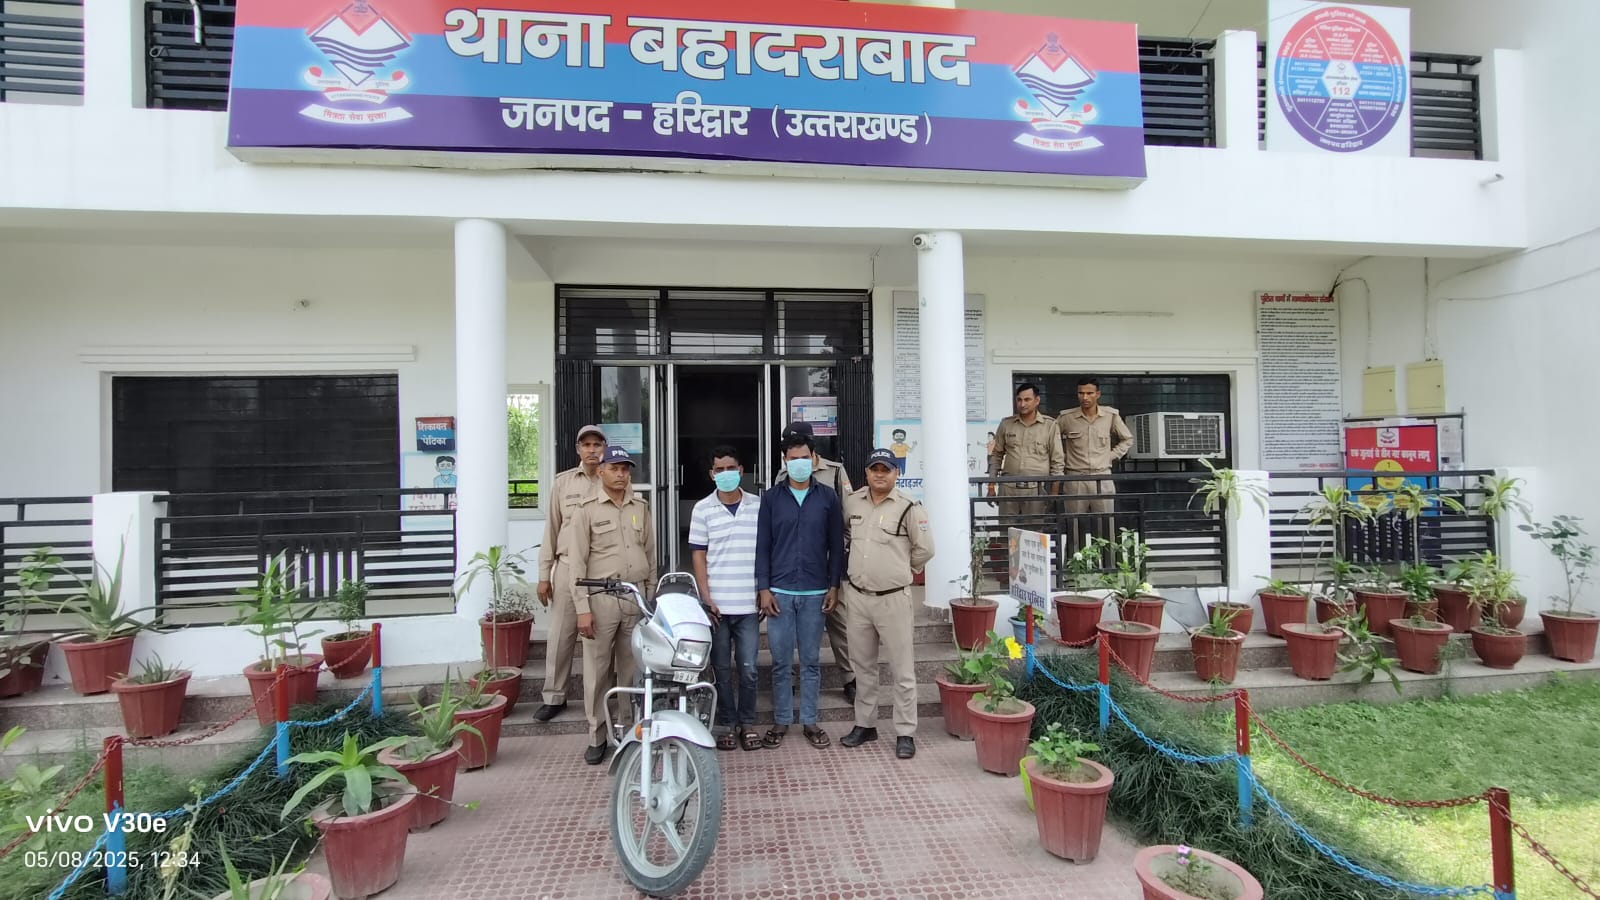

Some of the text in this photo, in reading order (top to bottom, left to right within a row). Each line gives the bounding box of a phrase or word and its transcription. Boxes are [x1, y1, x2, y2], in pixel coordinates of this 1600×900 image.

[444, 8, 977, 86] थाना बहादराबाद
[499, 97, 614, 133] जनपद
[651, 90, 752, 138] हरिद्वार
[771, 104, 933, 145] (उत्तराखण्ड)
[416, 421, 448, 432] शिकायत
[420, 434, 448, 446] पेटिका
